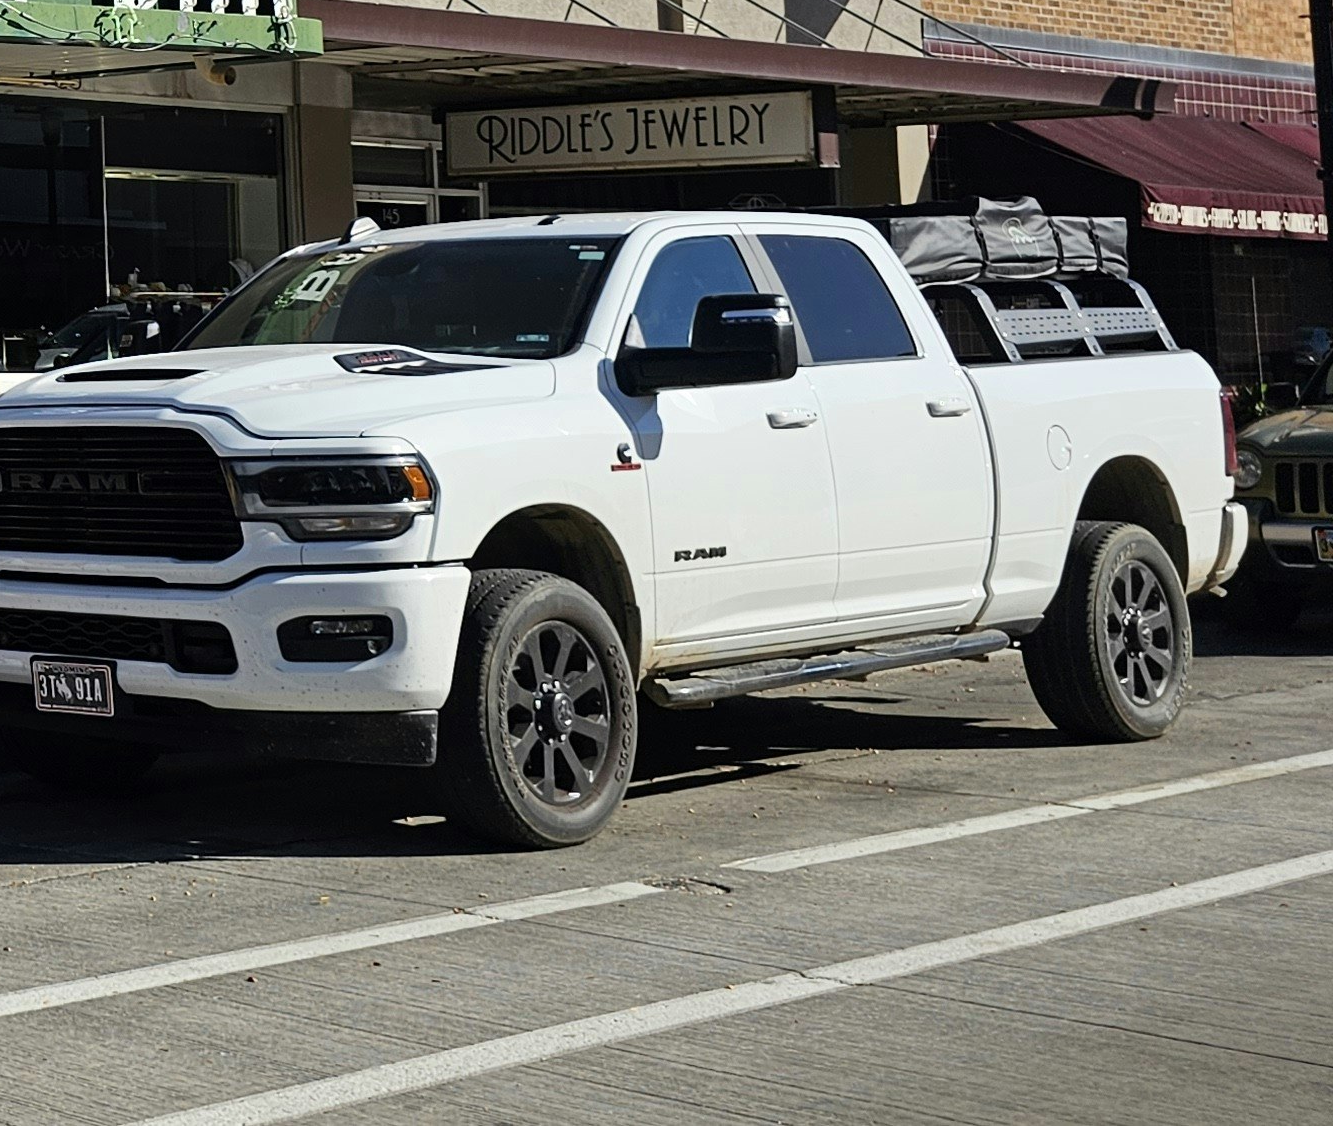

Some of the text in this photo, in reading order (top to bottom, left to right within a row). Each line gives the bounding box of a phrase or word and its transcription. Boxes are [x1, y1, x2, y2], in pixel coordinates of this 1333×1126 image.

[477, 102, 770, 164] RIDDLE'S JEWELRY
[380, 207, 397, 224] 145
[10, 472, 130, 490] RAM
[674, 546, 727, 562] RAM
[39, 674, 102, 702] 3T 91A
